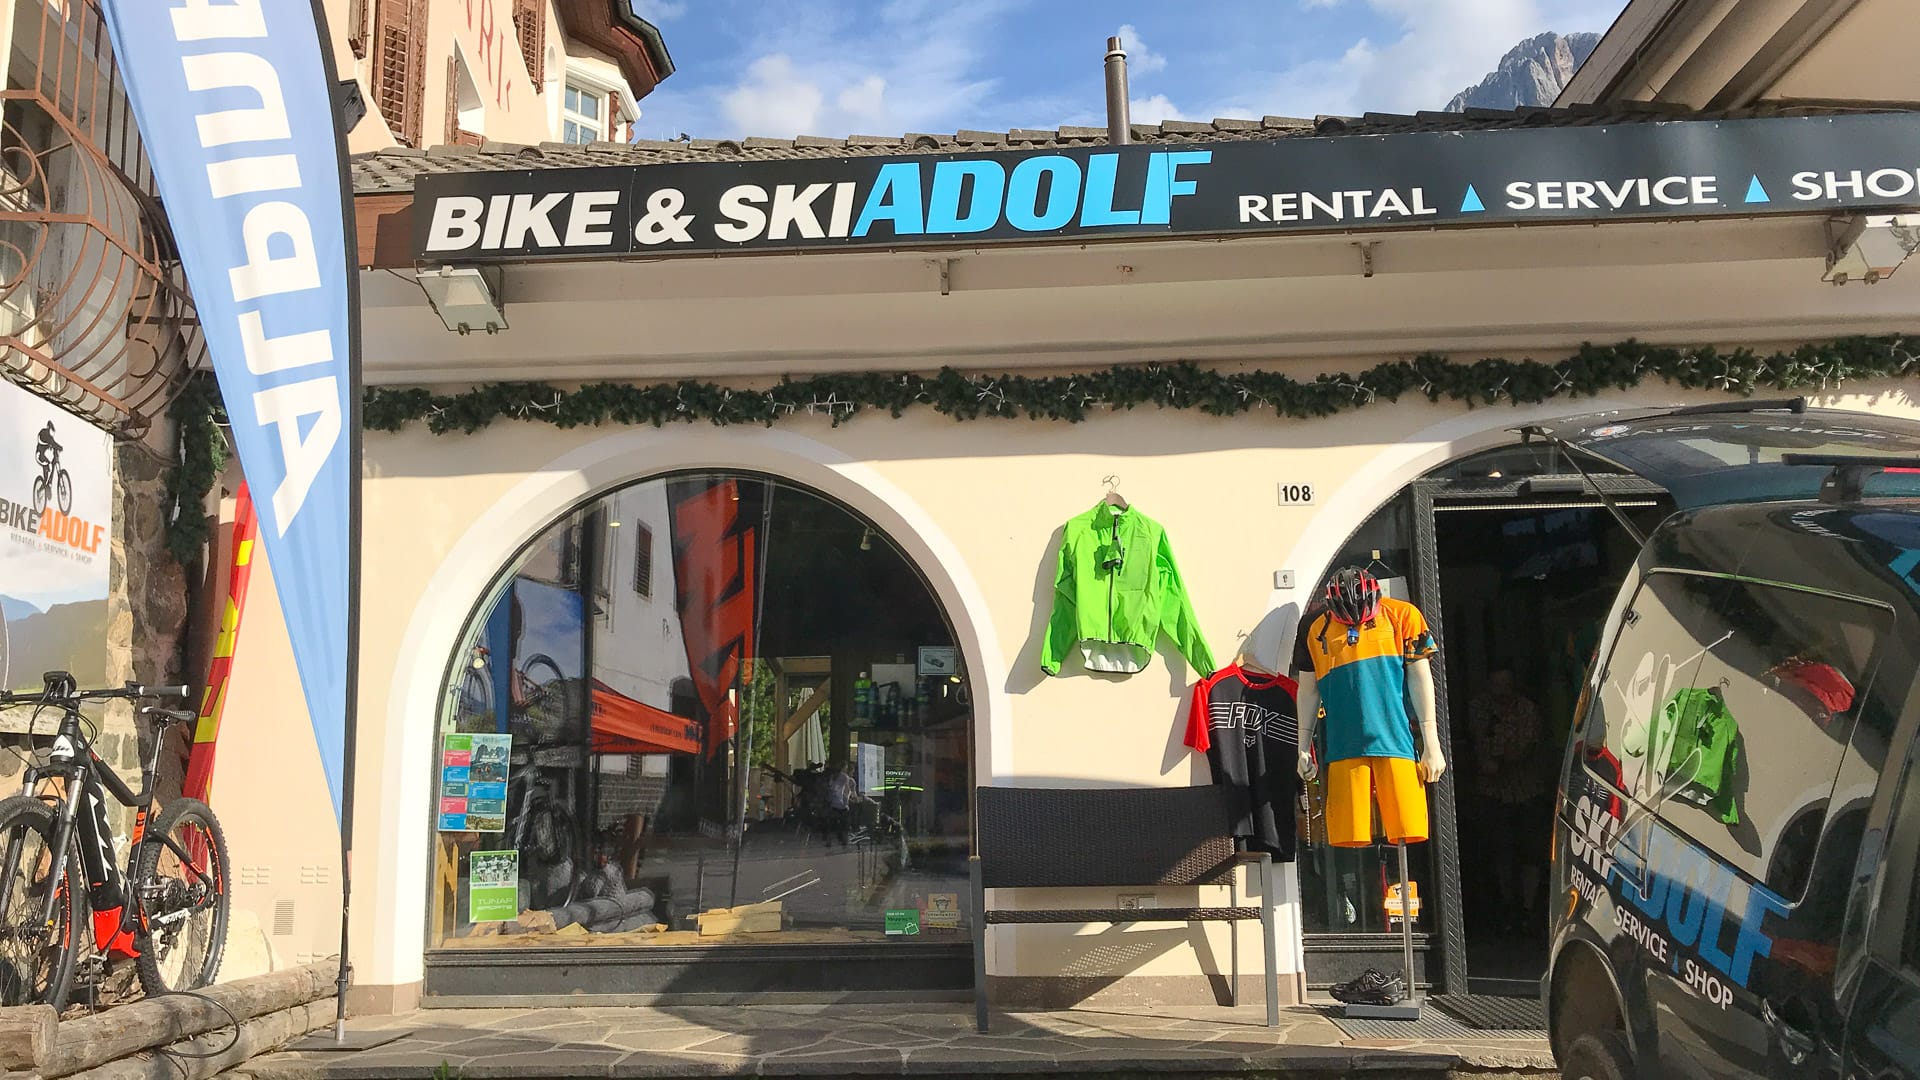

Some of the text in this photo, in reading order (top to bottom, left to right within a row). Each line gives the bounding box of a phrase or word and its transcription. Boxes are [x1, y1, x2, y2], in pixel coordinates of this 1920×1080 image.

[425, 190, 620, 252] BIKE
[634, 188, 697, 246] &
[1238, 187, 1437, 223] RENTAL
[1505, 176, 1719, 211] SERVICE
[1791, 167, 1920, 202] SHO
[1282, 485, 1312, 502] 108
[1227, 701, 1280, 735] FOX
[1570, 864, 1733, 1012] RENTAL SERVICE SHOP
